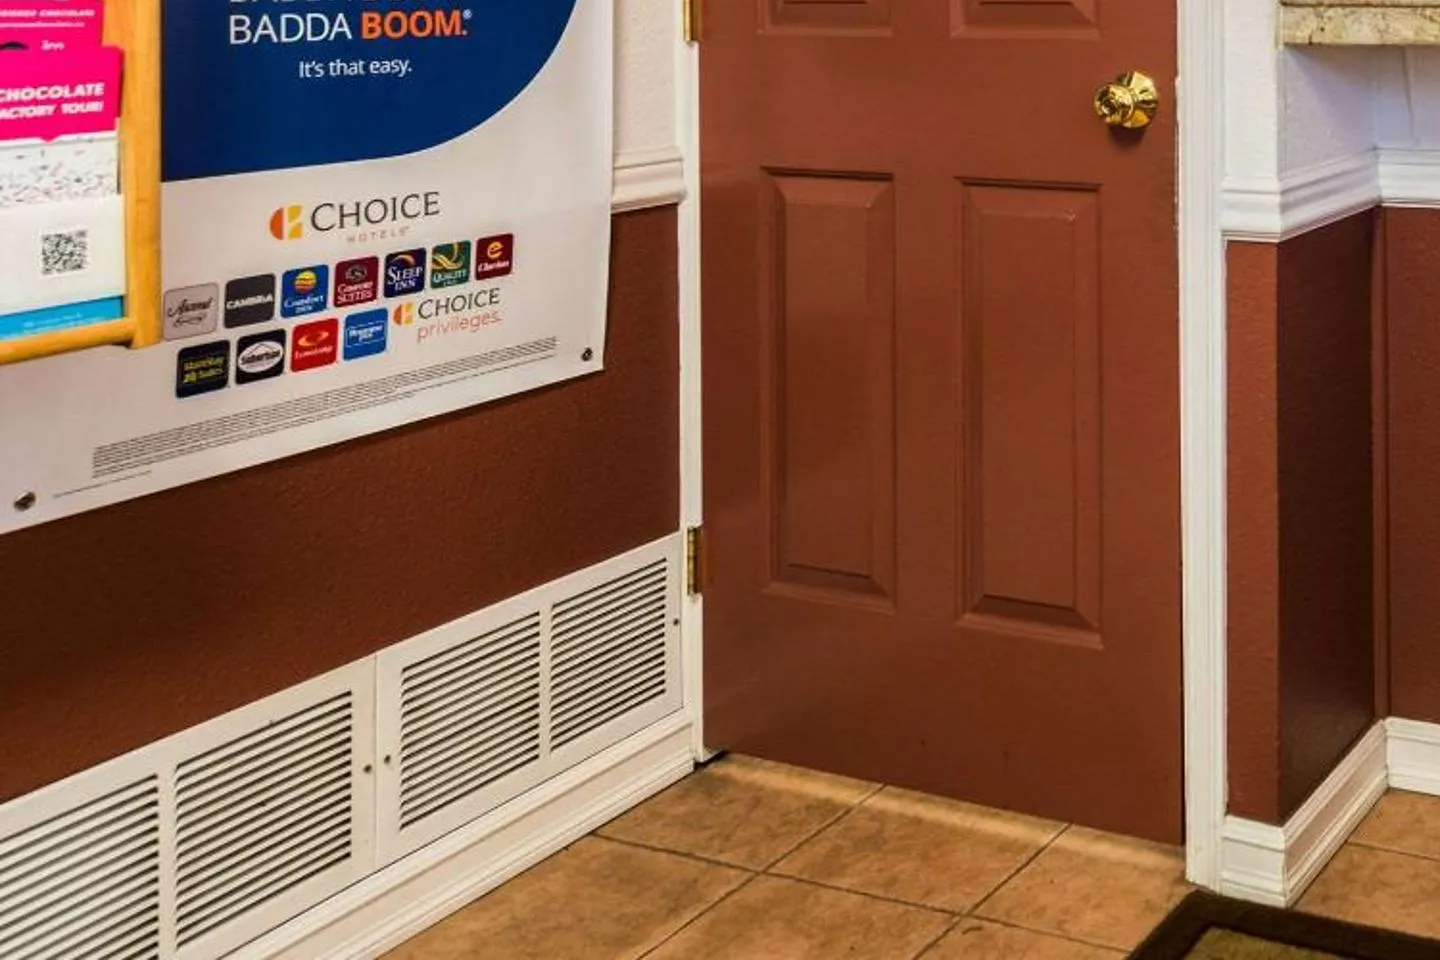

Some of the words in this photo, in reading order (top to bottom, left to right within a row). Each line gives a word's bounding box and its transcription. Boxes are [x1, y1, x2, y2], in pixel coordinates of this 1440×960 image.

[229, 12, 353, 44] BADDA
[299, 59, 324, 78] It's
[329, 58, 364, 77] that
[369, 58, 413, 78] easy.
[311, 191, 440, 232] CHOICE
[418, 288, 500, 319] CHOICE
